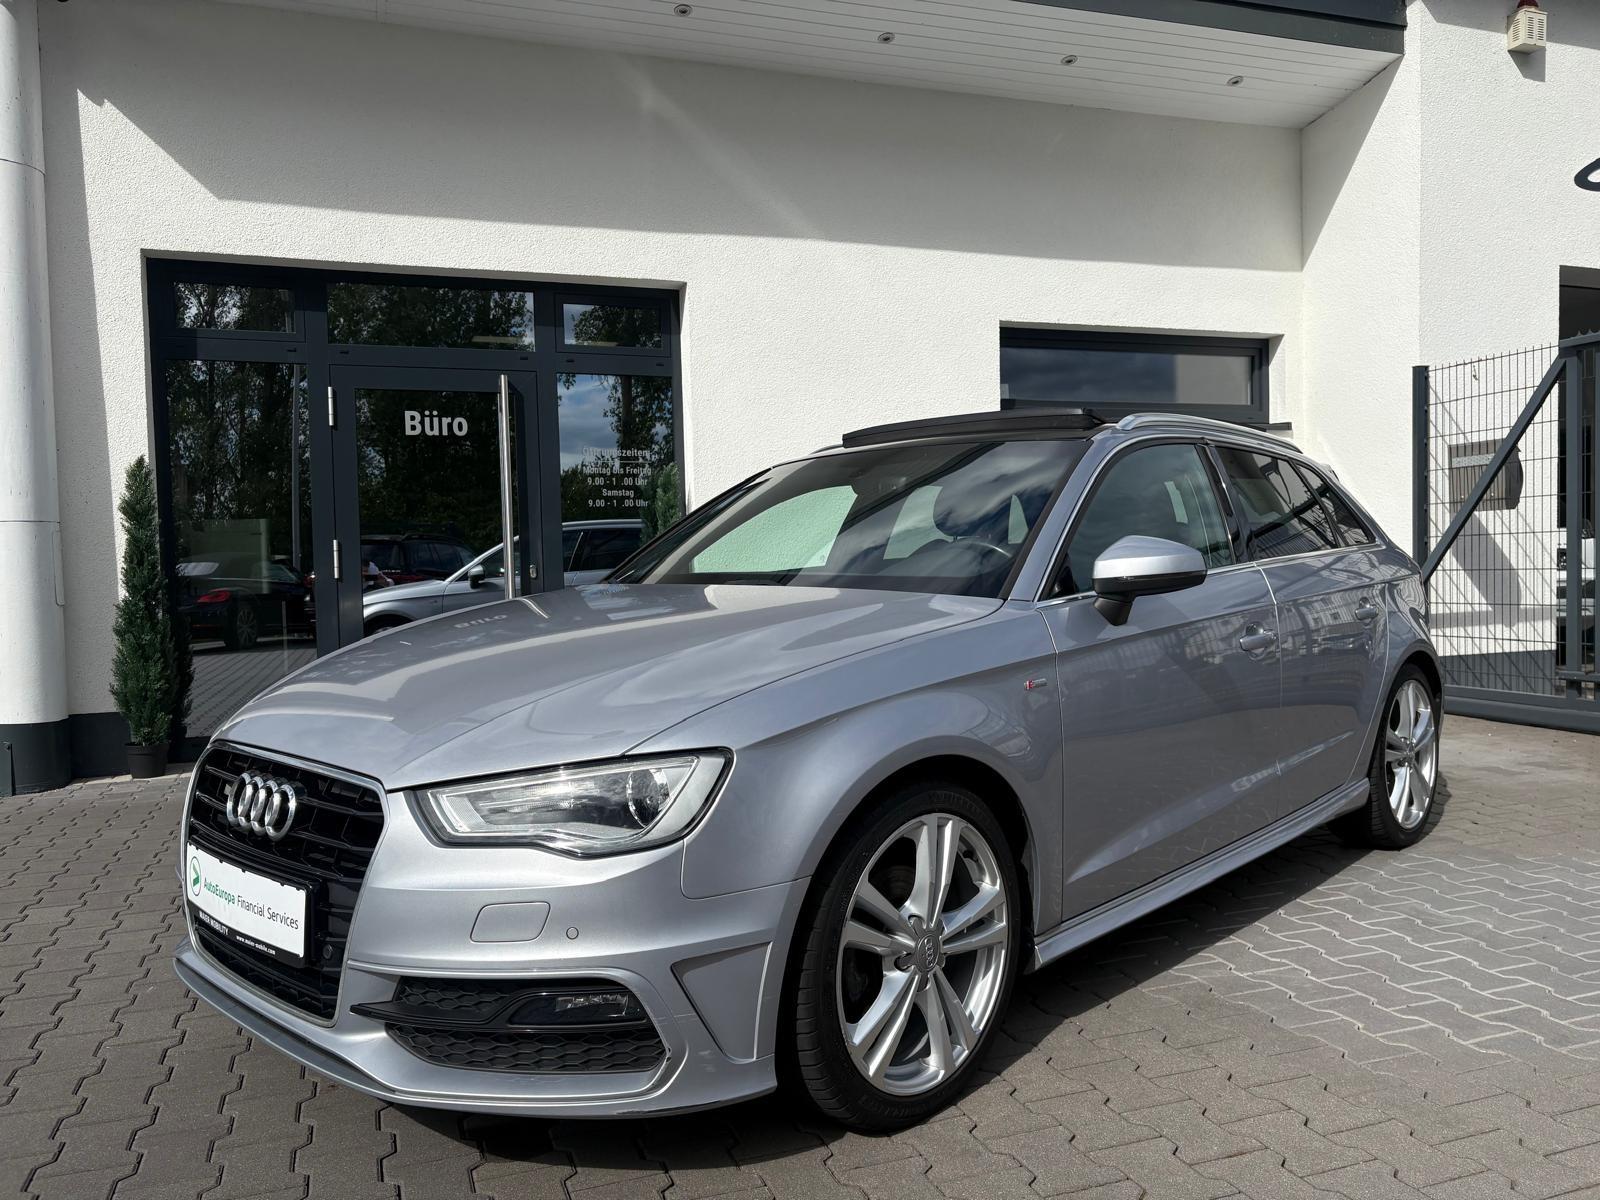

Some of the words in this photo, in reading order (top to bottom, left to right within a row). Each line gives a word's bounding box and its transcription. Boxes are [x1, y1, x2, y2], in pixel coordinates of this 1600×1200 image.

[404, 410, 468, 436] Büro
[583, 466, 611, 475] Montag
[612, 466, 624, 474] bis
[626, 466, 652, 475] Freitag
[587, 477, 605, 486] 9.00
[635, 477, 648, 486] Uhr
[602, 488, 635, 498] Samstag
[588, 499, 605, 508] 9.00
[635, 499, 648, 508] Uhr
[204, 877, 236, 906] AutoEuropa
[237, 895, 265, 918] Financial
[267, 907, 299, 930] Services
